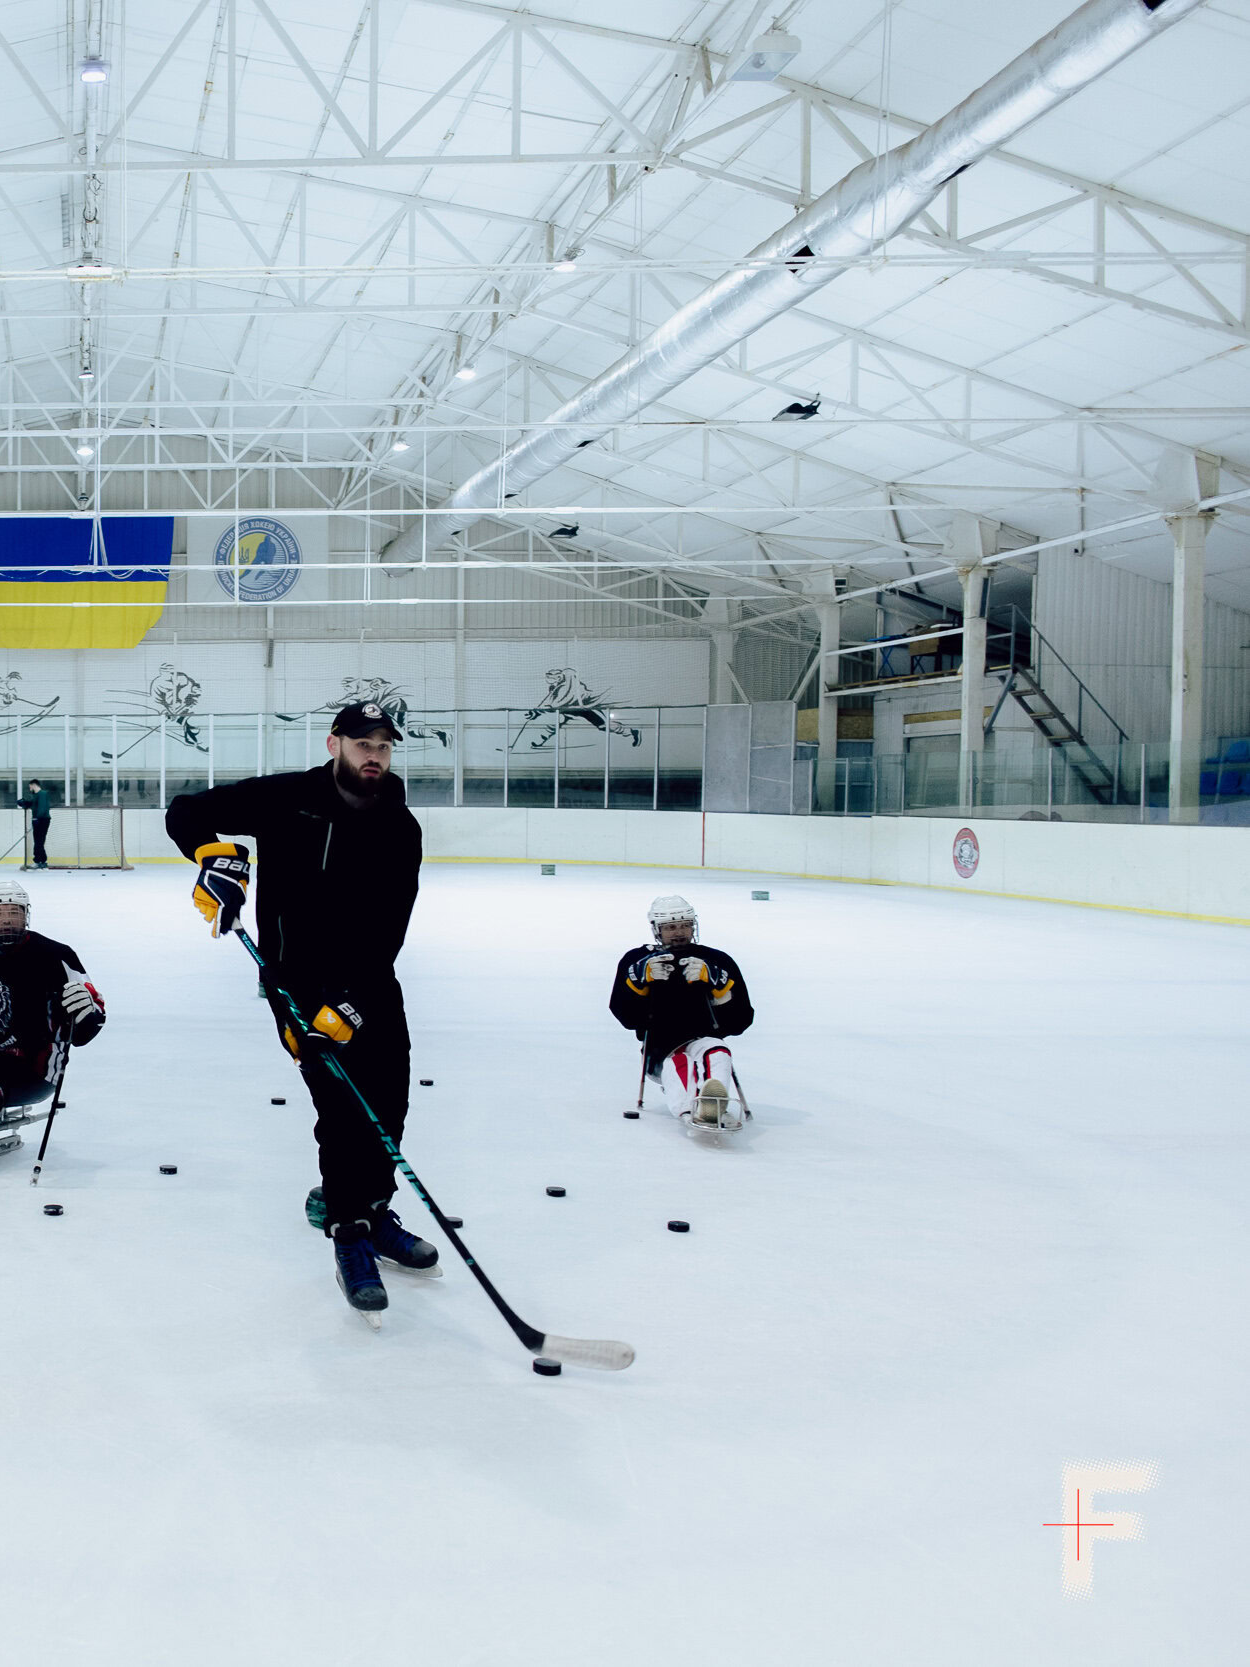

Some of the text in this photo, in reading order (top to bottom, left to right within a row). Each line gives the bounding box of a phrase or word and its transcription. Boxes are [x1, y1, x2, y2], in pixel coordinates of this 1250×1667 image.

[219, 521, 297, 555] ФЕДЕРЦІЯ ХОКЕЮ УКРАЇНИ
